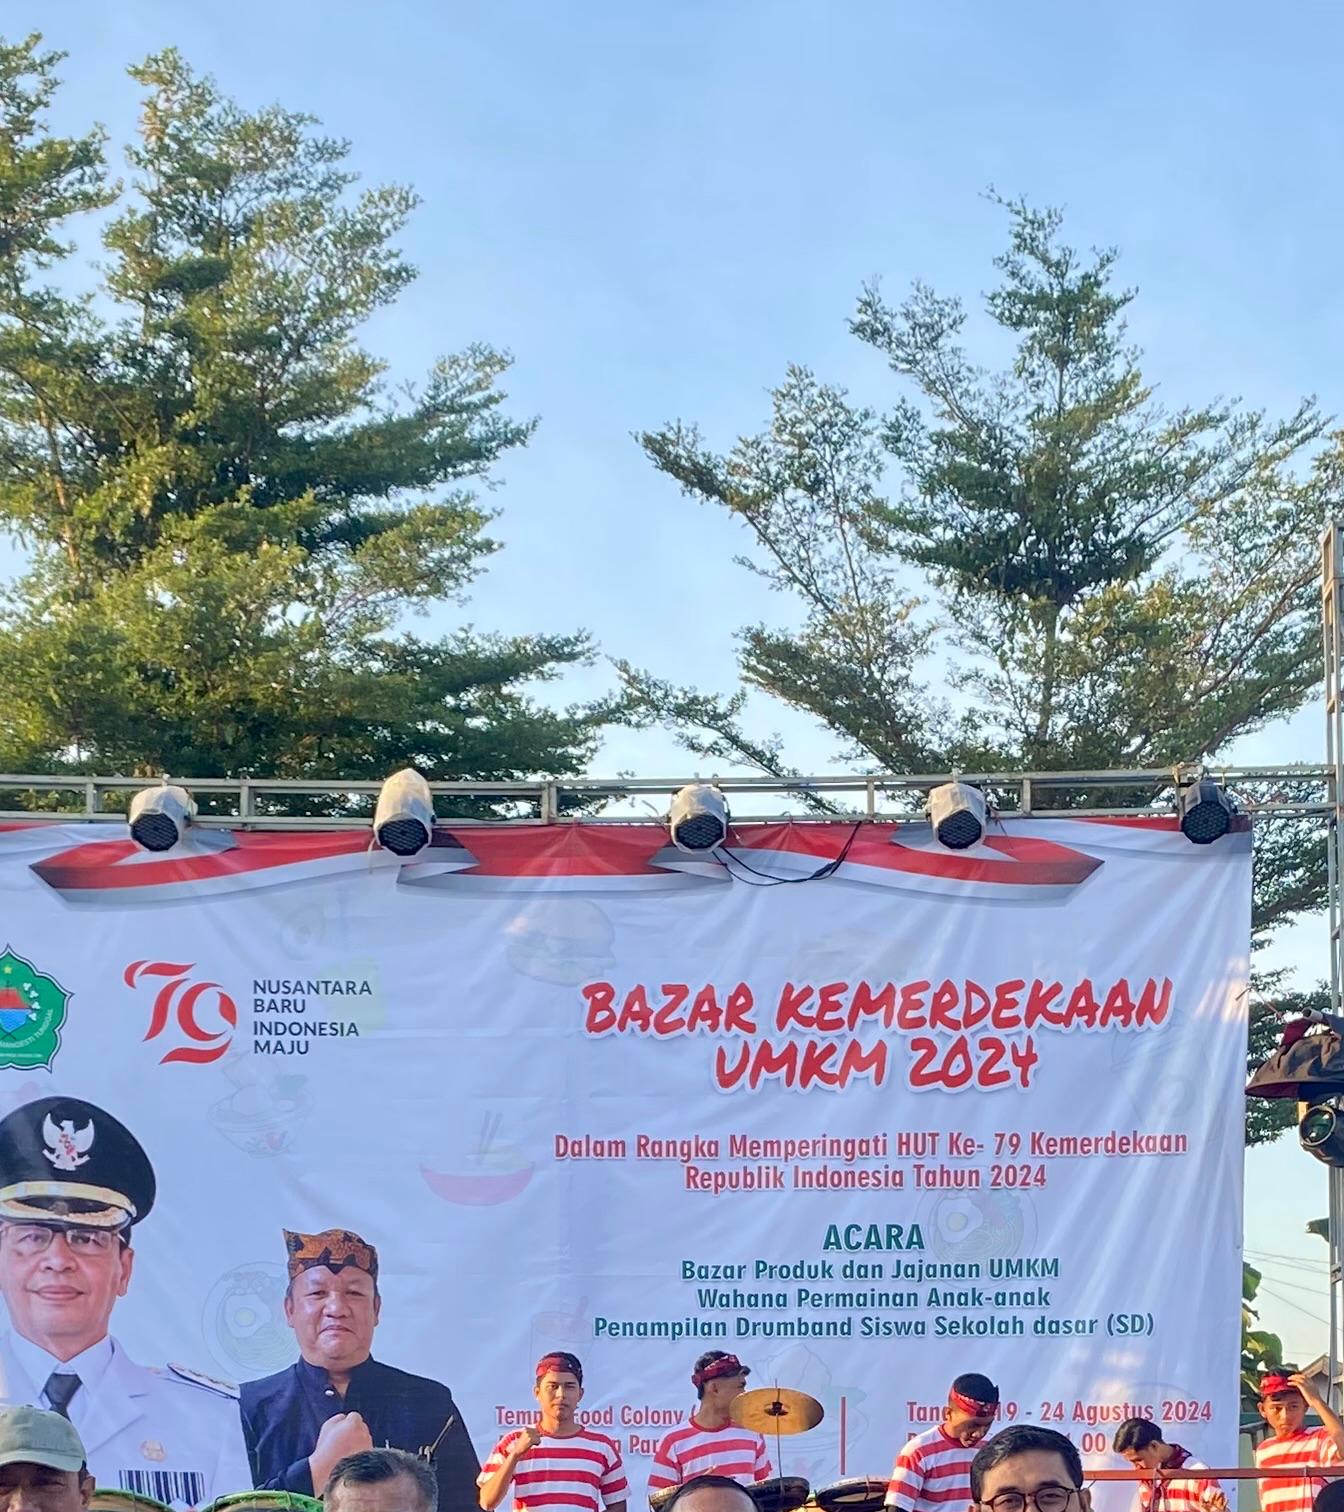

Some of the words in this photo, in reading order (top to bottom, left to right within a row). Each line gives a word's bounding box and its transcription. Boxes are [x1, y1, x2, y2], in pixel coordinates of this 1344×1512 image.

[254, 980, 371, 995] NUSANTARA
[254, 999, 305, 1013] BARU
[582, 982, 757, 1034] BAZAR
[775, 978, 1173, 1031] KEMERDEKAAN
[254, 1022, 358, 1036] INDONESIA
[255, 1040, 308, 1054] MAJU
[716, 1038, 886, 1089] UMKM
[909, 1036, 1038, 1089] 2024
[556, 1136, 625, 1157] Dalam
[637, 1136, 719, 1163] Rangka
[730, 1136, 886, 1161] Memperingati
[898, 1133, 939, 1156] HUT
[949, 1133, 984, 1155] Ke-
[994, 1133, 1021, 1156] 79
[1031, 1133, 1186, 1155] Kemerdekaan
[686, 1166, 783, 1193] Republik
[794, 1166, 903, 1187] Indonesia
[914, 1164, 979, 1187] Tahun
[992, 1165, 1045, 1186] 2024
[824, 1224, 924, 1250] ACARA
[683, 1261, 746, 1279] Bazar
[756, 1260, 833, 1279] Produk
[843, 1260, 882, 1278] dan
[892, 1260, 979, 1282] Jajanan
[990, 1258, 1058, 1277] UMKM
[698, 1289, 787, 1307] Wahana
[798, 1288, 917, 1307] Permainan
[927, 1287, 1049, 1306] Anak-anak
[595, 1318, 726, 1340] Penampilan
[737, 1317, 851, 1336] Drumband
[861, 1317, 925, 1335] Siswa
[935, 1316, 1023, 1335] Sekolah
[1034, 1316, 1097, 1334] dasar
[1106, 1314, 1155, 1337] (SD)
[1039, 1400, 1065, 1421] 24
[1072, 1401, 1154, 1425] Agustus
[1162, 1400, 1213, 1421] 2024
